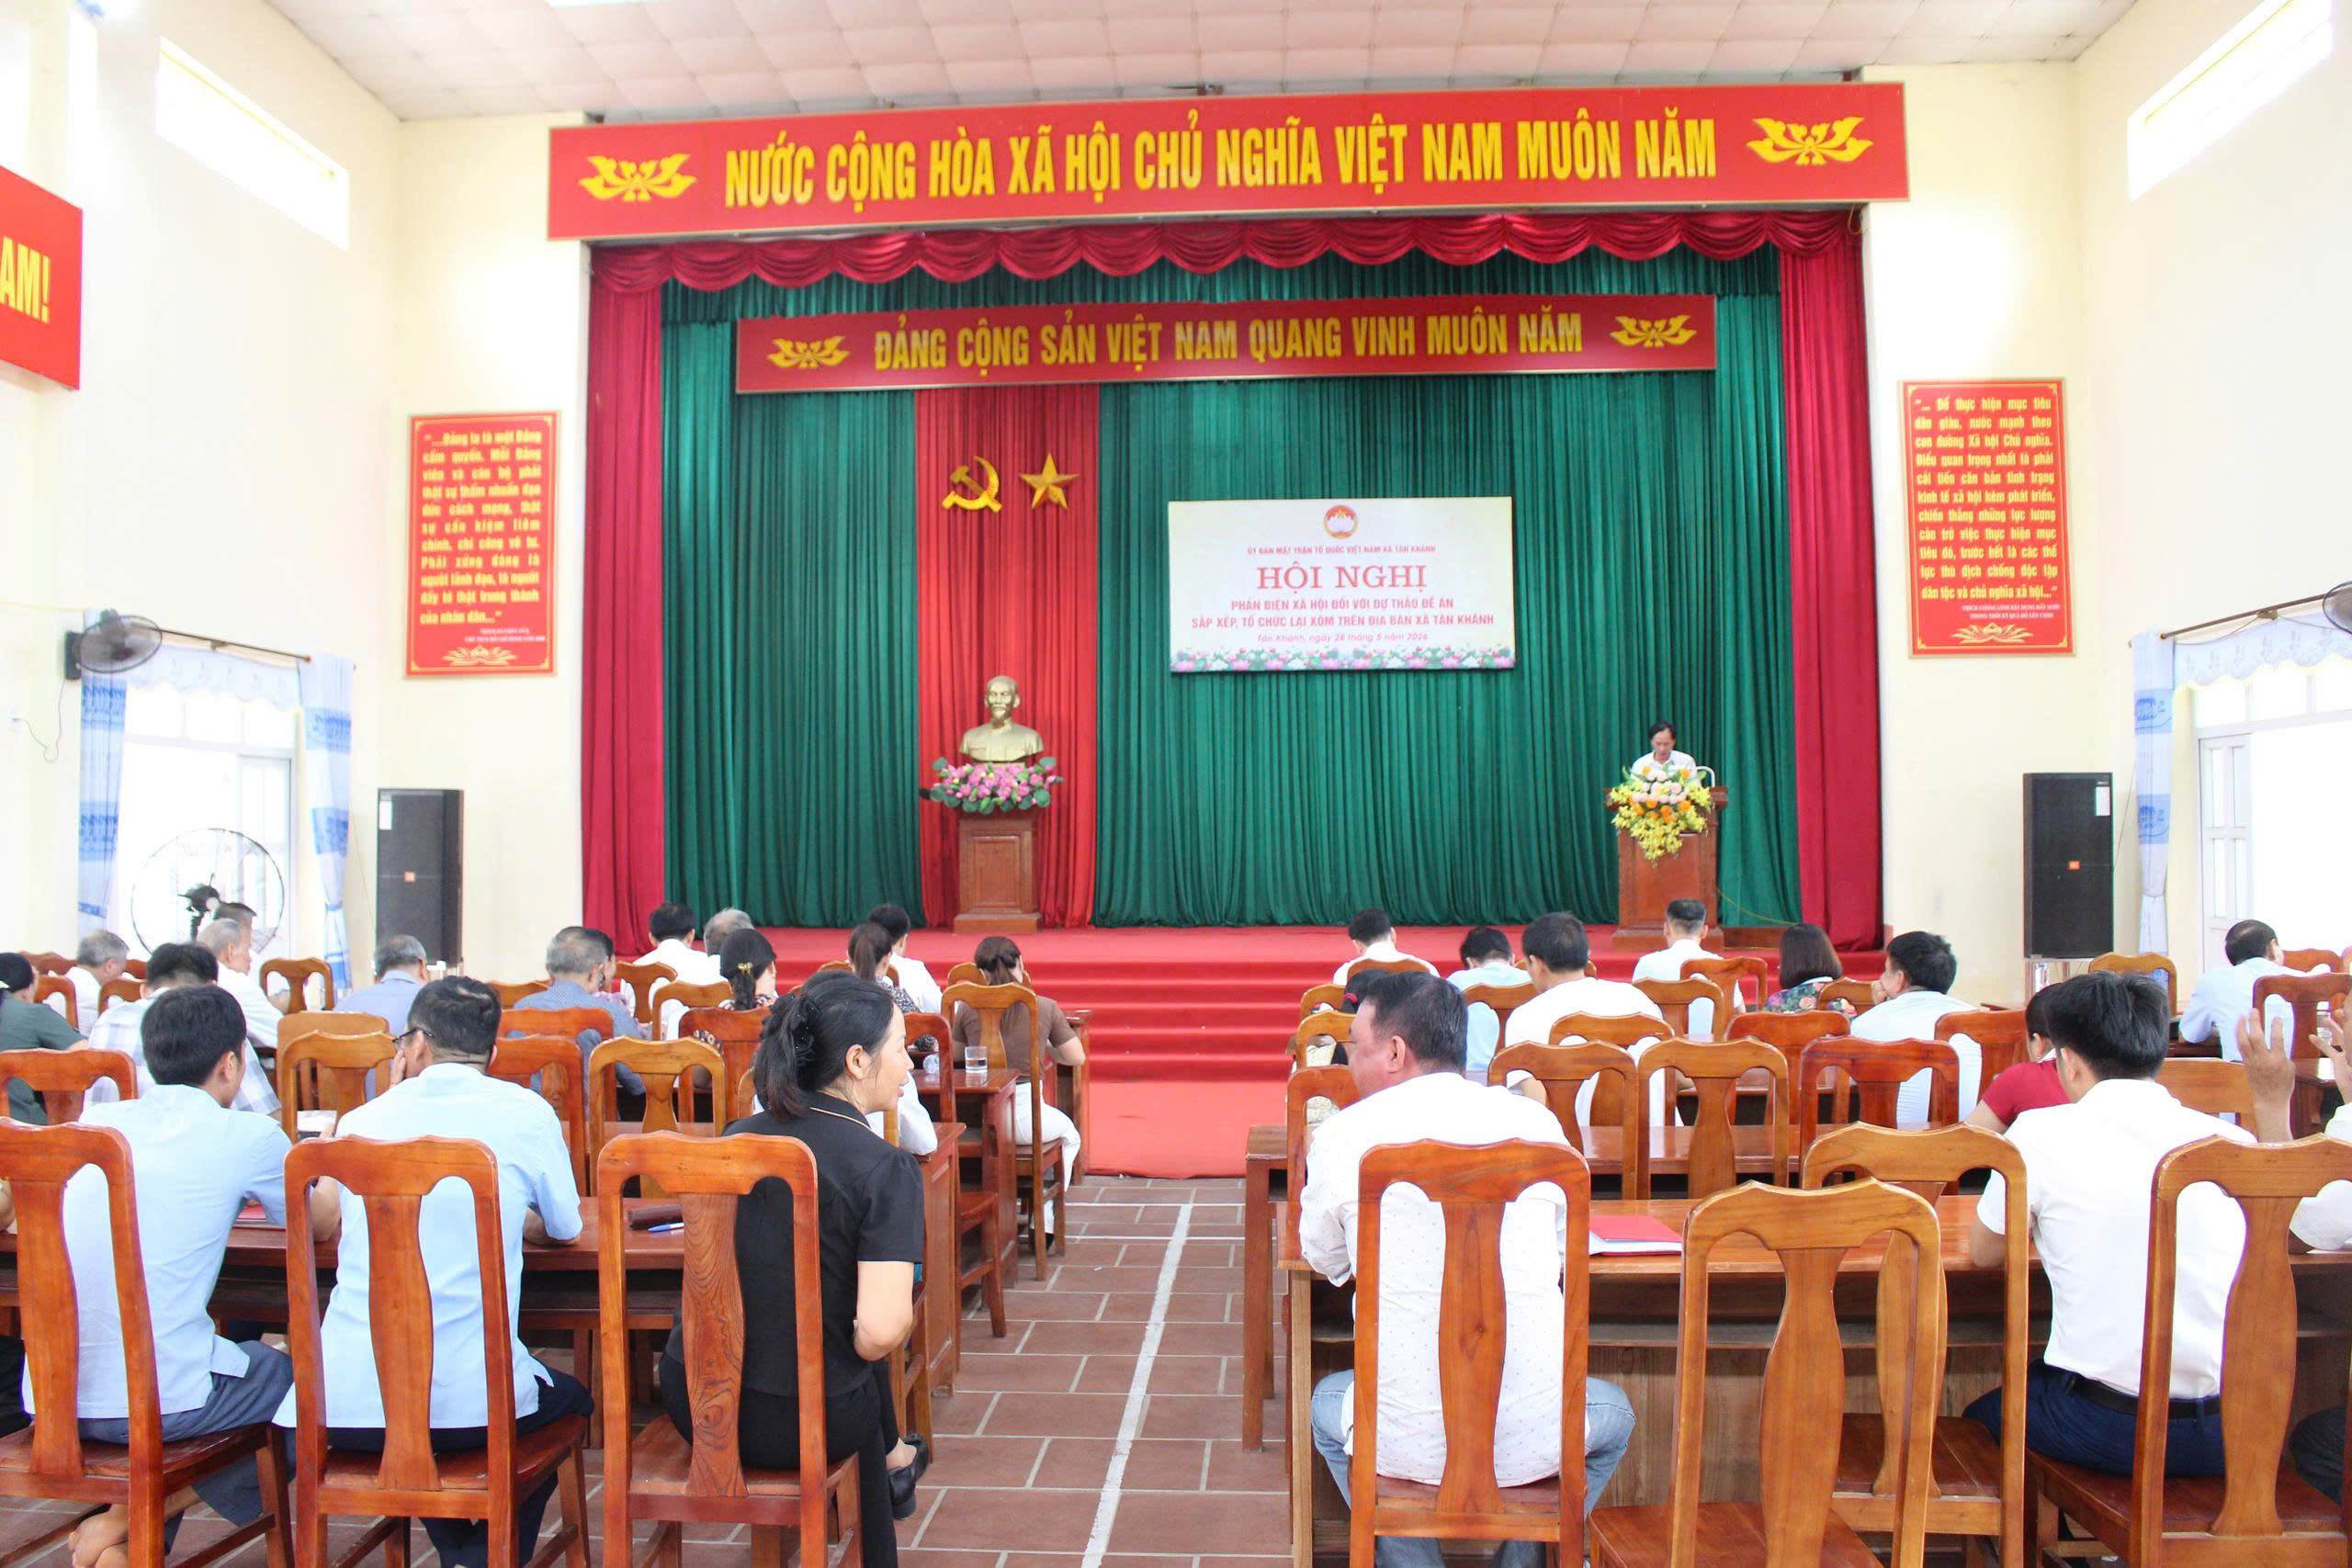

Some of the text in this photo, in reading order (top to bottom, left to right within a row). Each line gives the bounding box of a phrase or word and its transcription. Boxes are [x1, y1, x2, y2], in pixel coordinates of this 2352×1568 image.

[725, 106, 1718, 215] NƯỚC CỘNG HÒA XÃ HỘI CHỦ NGHĨA VIỆT NAM MUÔN NĂM
[0, 234, 51, 323] AM!
[874, 303, 1585, 378] ĐẢNG CỘNG SẢN VIỆT NAM QUANG VINH MUÔN NĂM
[1230, 595, 1453, 612] PHẢN BIỆN XÃ HỘI ĐỐI VỚI DỰ THẢO ĐỀ ÁN
[1256, 559, 1427, 594] HỘI NGHỊ
[1191, 616, 1213, 628] SẮP
[1241, 615, 1254, 628] TỔ
[1257, 615, 1286, 627] CHỨC
[1289, 615, 1306, 627] LẠI
[1310, 614, 1334, 626] XÓM
[1337, 614, 1365, 626] TRÊN
[1367, 615, 1386, 626] ĐỊA
[1389, 614, 1412, 625] BÀN
[1415, 614, 1430, 625] XÃ
[1432, 613, 1453, 625] TÂN
[1456, 613, 1494, 625] KHÁNH
